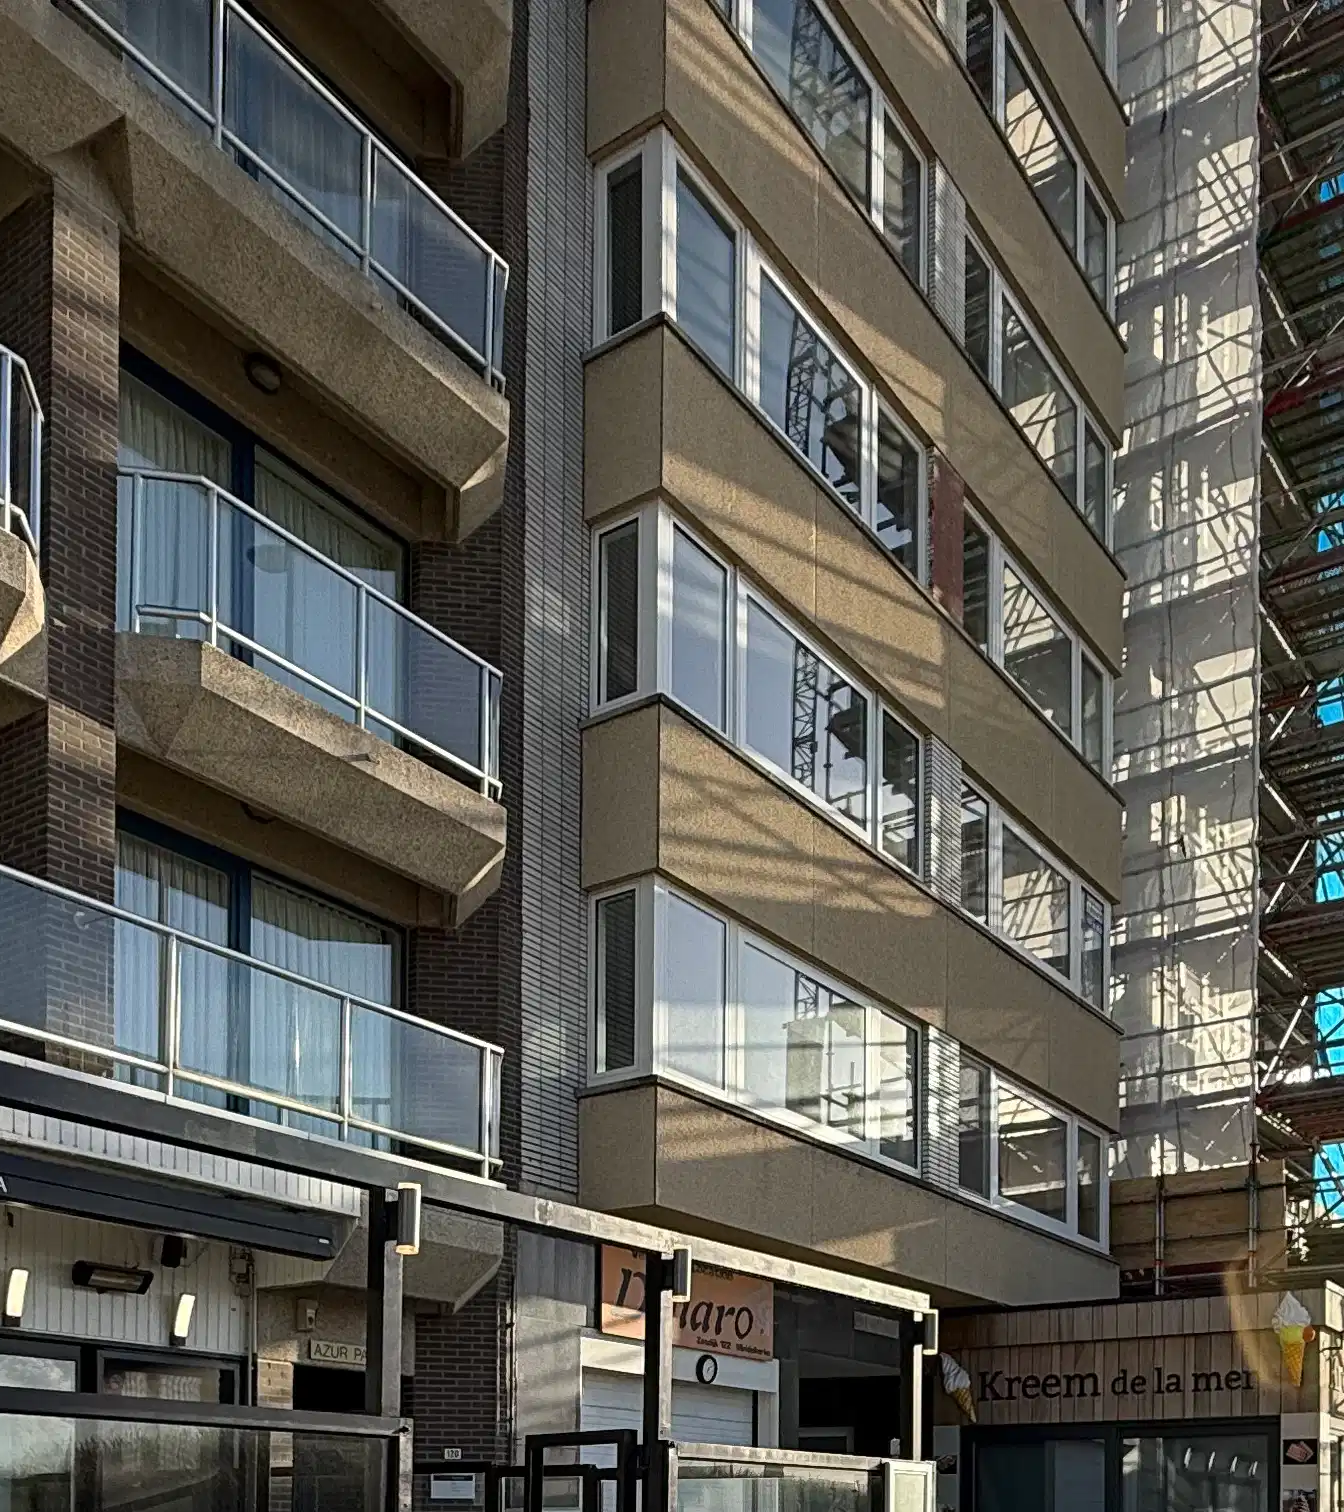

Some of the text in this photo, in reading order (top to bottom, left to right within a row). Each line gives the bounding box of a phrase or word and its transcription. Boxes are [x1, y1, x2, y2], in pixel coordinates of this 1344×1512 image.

[314, 1344, 348, 1360] AZUR
[977, 1367, 1256, 1401] Kreem de la mer
